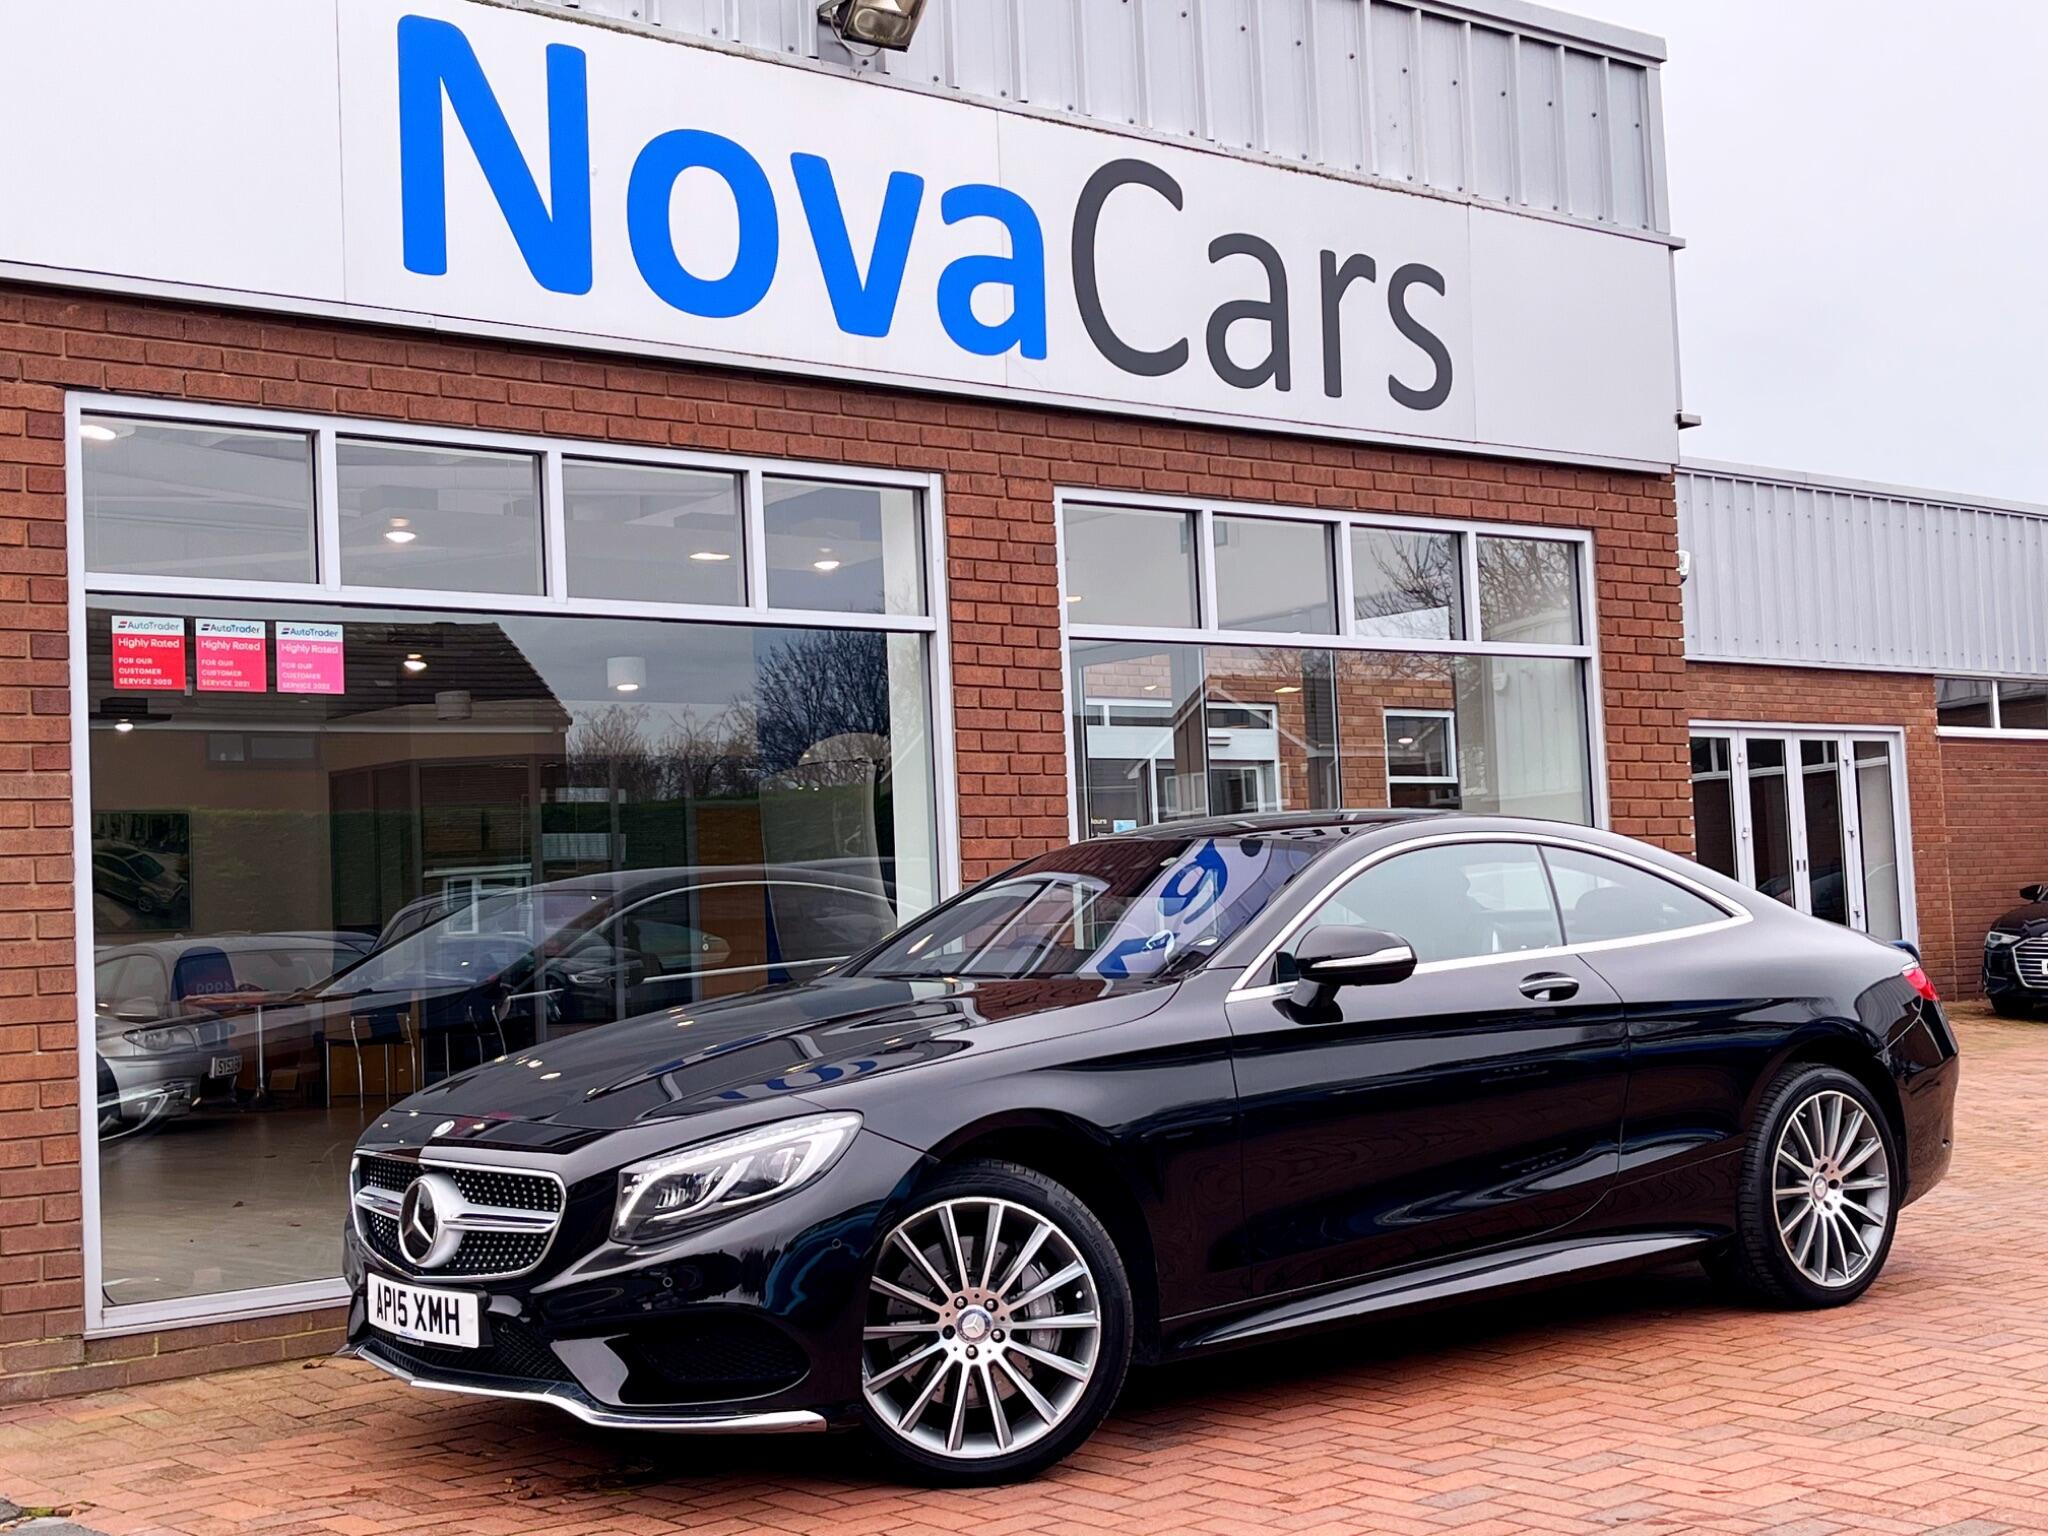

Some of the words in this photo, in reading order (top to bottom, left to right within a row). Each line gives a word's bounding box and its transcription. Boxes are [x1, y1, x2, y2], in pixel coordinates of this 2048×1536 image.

[127, 621, 180, 631] AutoTrader
[210, 624, 260, 634] AutoTrader
[290, 628, 339, 638] AutoTrader
[118, 638, 149, 649] Highly
[150, 639, 180, 649] Rated
[201, 640, 231, 651] Highly
[232, 641, 261, 651] Rated
[281, 643, 310, 655] Highly
[311, 645, 338, 654] Rated
[136, 657, 153, 665] OUR
[118, 667, 162, 675] CUSTOMER
[201, 669, 243, 677] CUSTOMER
[282, 672, 321, 680] CUSTOMER
[119, 677, 152, 685] SERVICE
[202, 679, 232, 687] SERVICE
[377, 1283, 408, 1328] AP15
[413, 1293, 460, 1336] XMH
